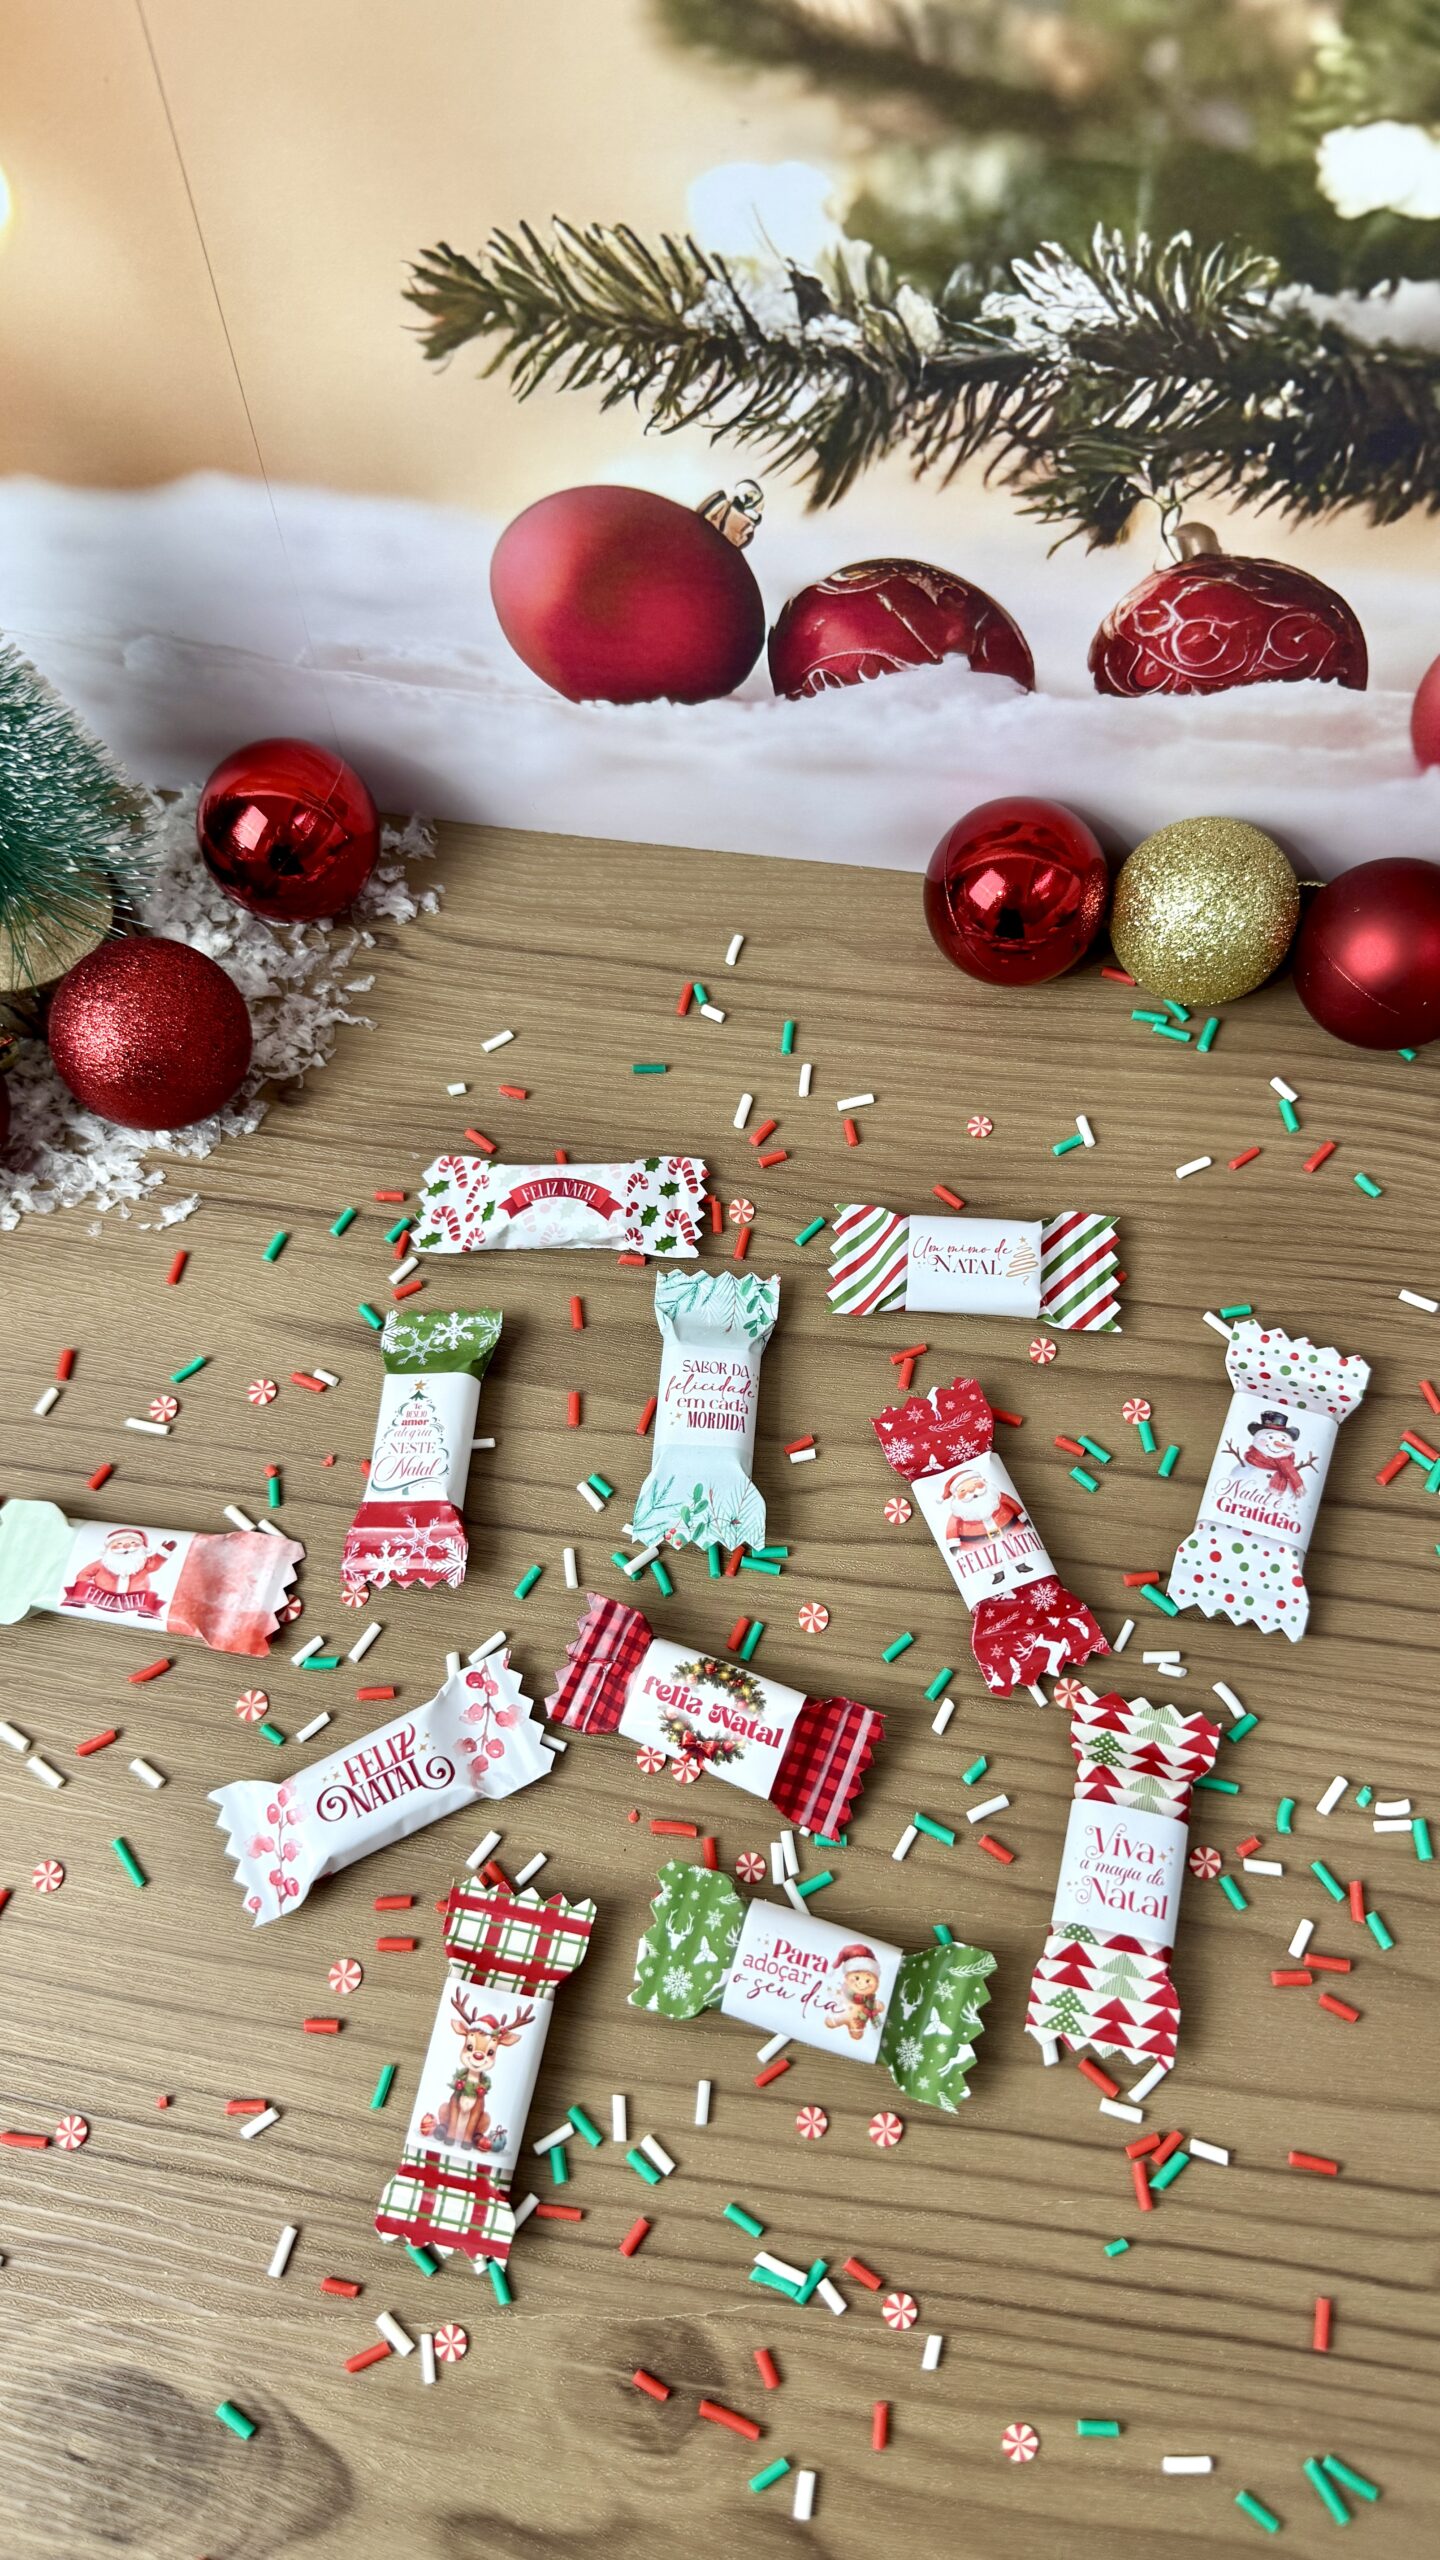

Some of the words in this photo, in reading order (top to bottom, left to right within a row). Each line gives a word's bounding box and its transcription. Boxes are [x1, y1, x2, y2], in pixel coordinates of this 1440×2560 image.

[521, 1181, 558, 1202] FELIZ
[562, 1180, 598, 1203] NATAL
[912, 1235, 944, 1259] Um
[947, 1243, 990, 1254] mimo
[994, 1238, 1012, 1260] de
[927, 1255, 1002, 1275] NATAL
[682, 1360, 728, 1375] SABOR
[732, 1363, 750, 1379] DA
[665, 1374, 755, 1402] felicidade
[677, 1398, 705, 1409] em
[709, 1399, 749, 1414] cada
[687, 1411, 746, 1433] MORDIDA
[390, 1441, 436, 1454] NESTE
[374, 1456, 441, 1482] Natal
[1214, 1478, 1272, 1506] Natal
[1216, 1497, 1302, 1534] Gratidão
[956, 1544, 1003, 1578] FELIZ
[708, 1703, 784, 1748] Natal
[343, 1722, 416, 1787] FELIZ
[316, 1756, 455, 1822] NATAL
[1085, 1823, 1154, 1864] Viva
[1079, 1859, 1090, 1870] a
[1095, 1861, 1142, 1886] magia
[1146, 1867, 1165, 1887] do
[1075, 1875, 1168, 1920] Natal
[743, 1953, 812, 1985] adoçar
[772, 1938, 829, 1974] Para
[733, 1973, 748, 1983] o
[746, 1978, 796, 1999] seu
[800, 1980, 845, 2019] dia
